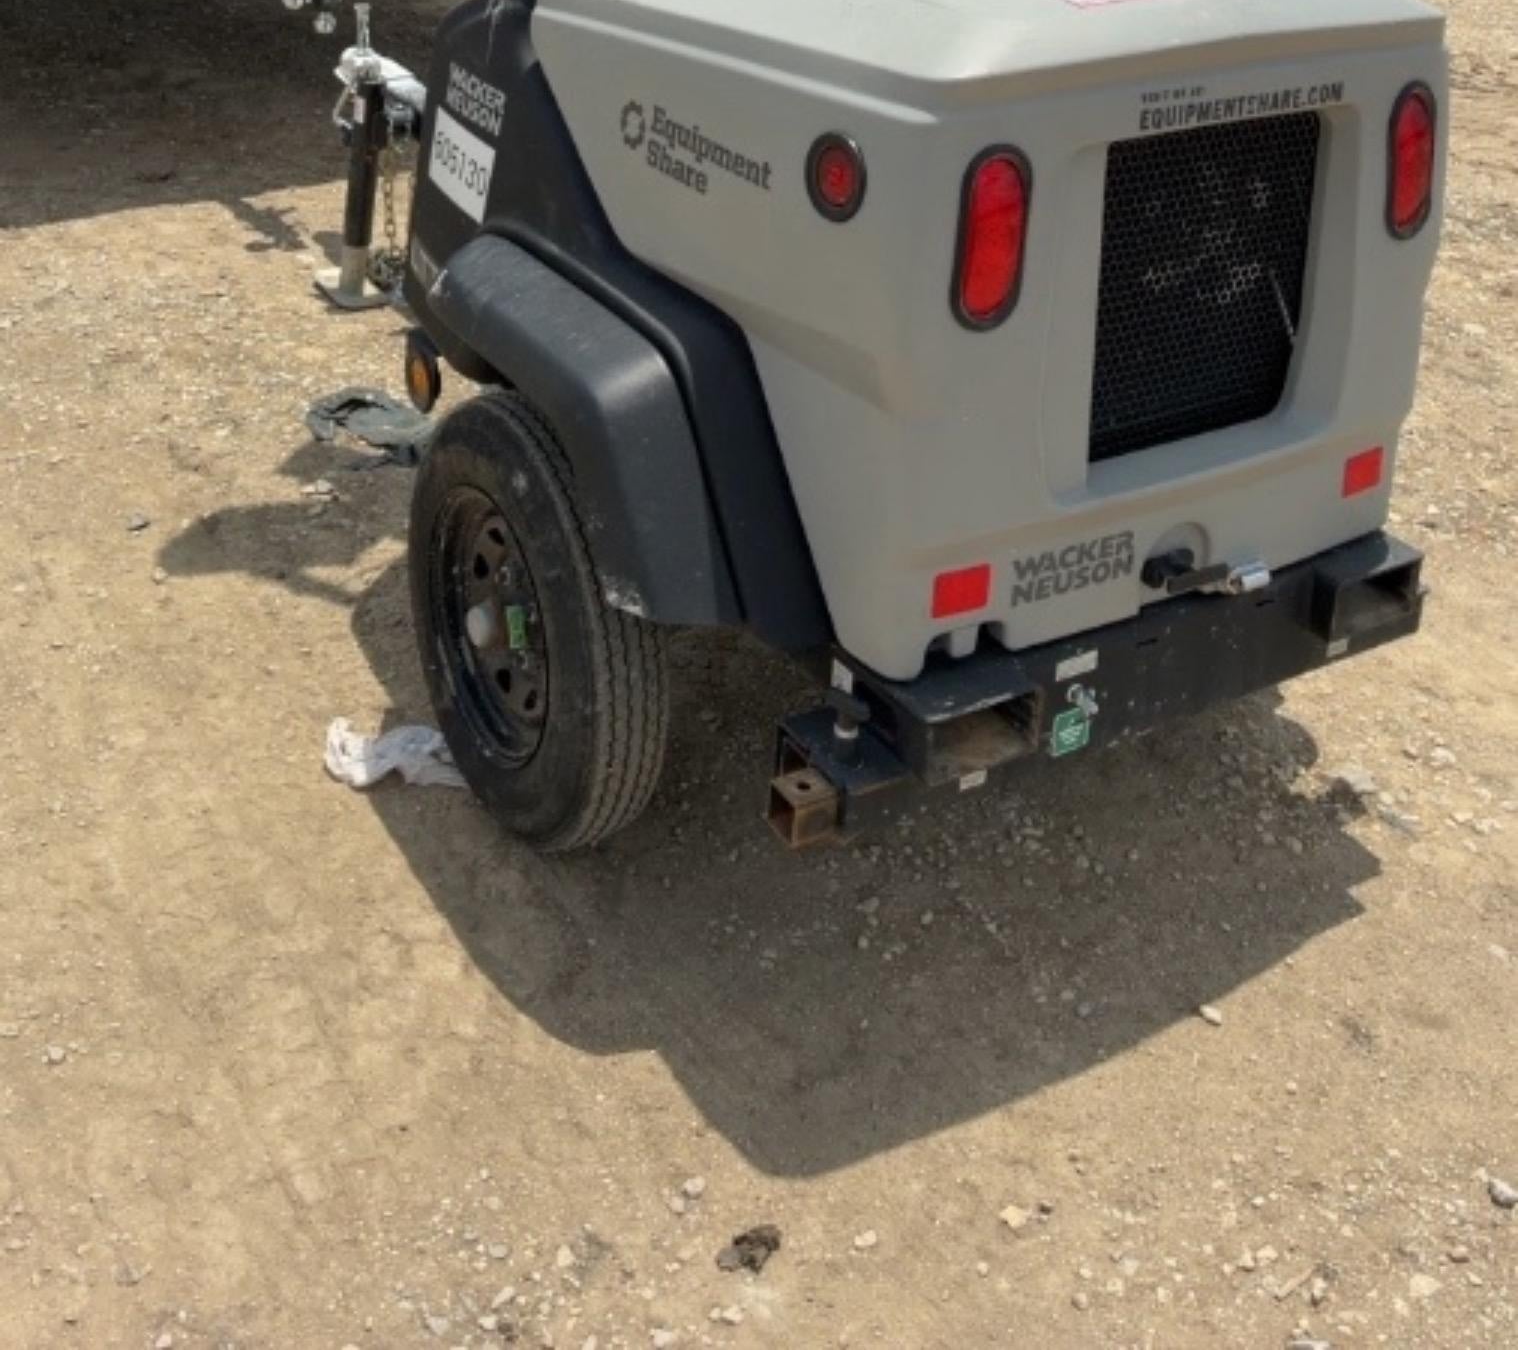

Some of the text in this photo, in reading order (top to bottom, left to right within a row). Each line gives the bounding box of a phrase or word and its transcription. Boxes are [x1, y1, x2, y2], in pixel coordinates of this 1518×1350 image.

[1139, 80, 1345, 131] EQUIPMENTSHARE.COM
[645, 138, 709, 196] Share
[650, 104, 773, 191] Equipment
[1010, 553, 1134, 607] NEUSON
[1011, 530, 1135, 581] WACKER
